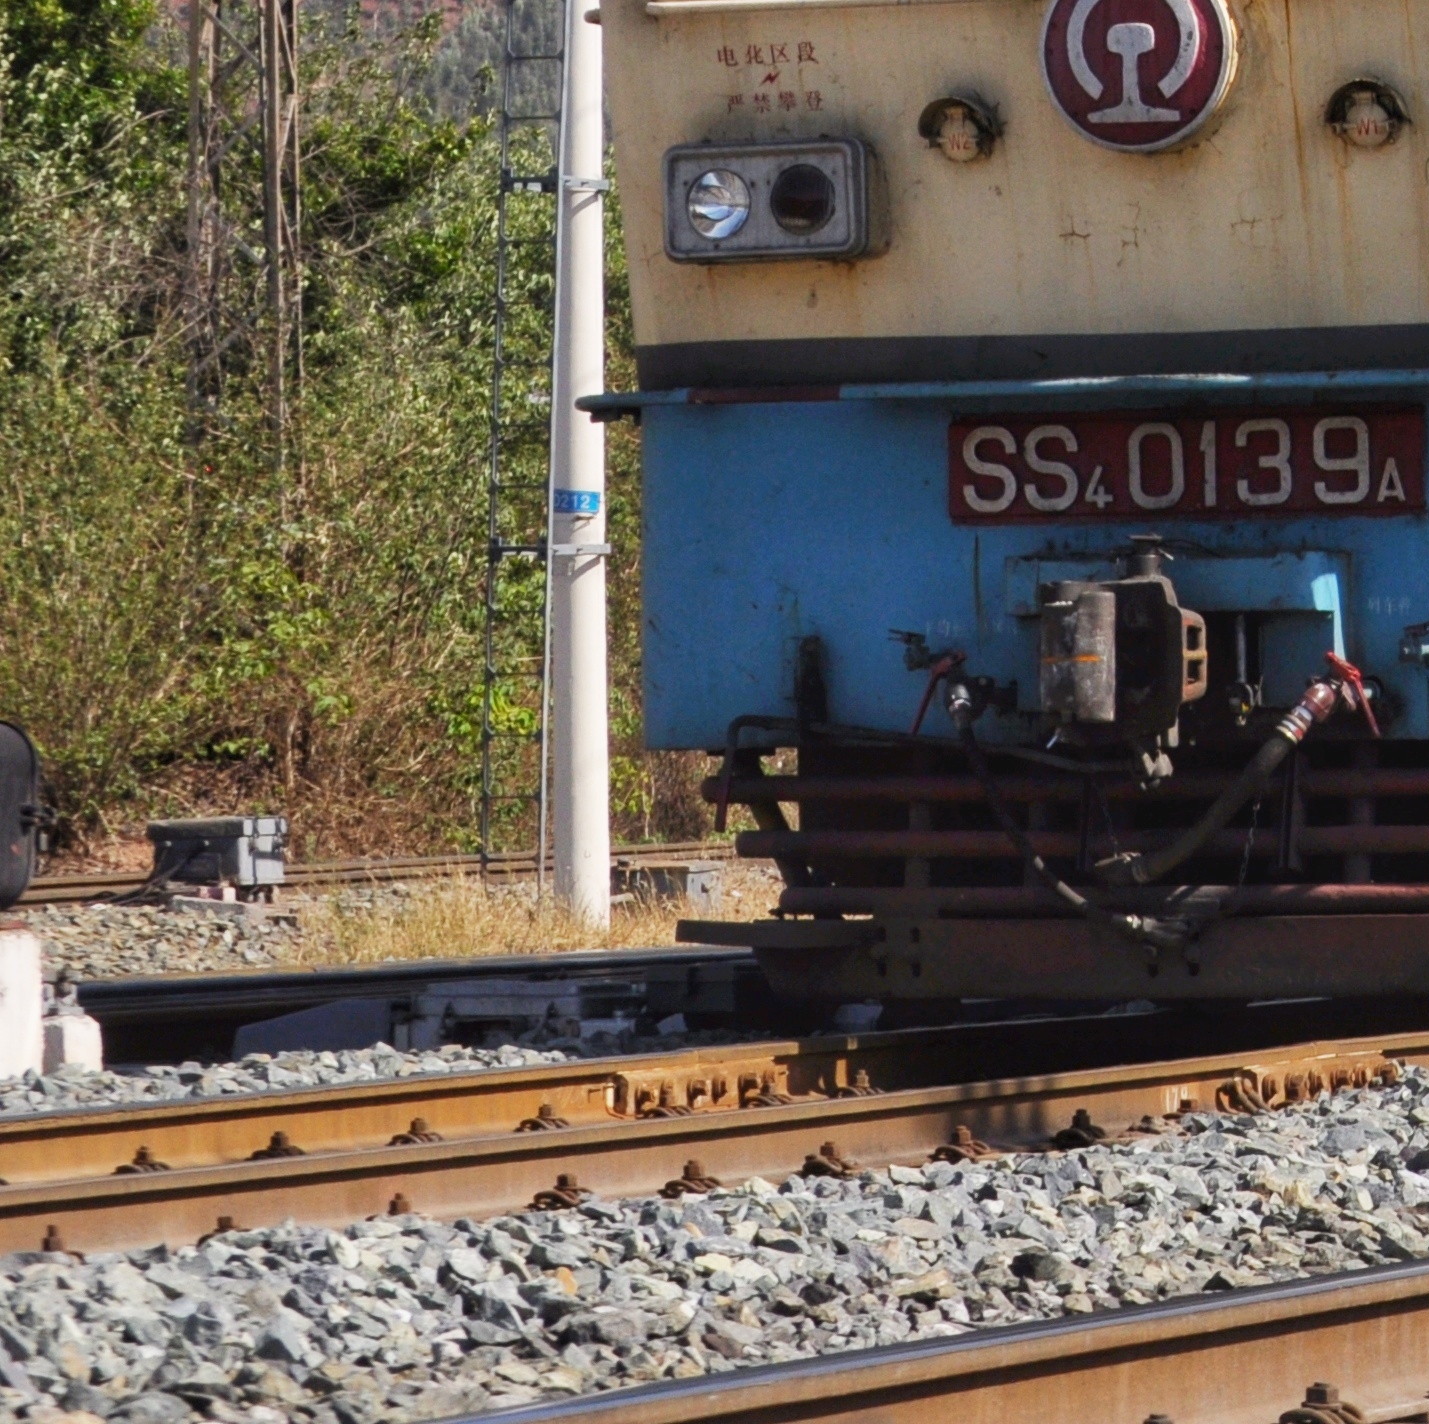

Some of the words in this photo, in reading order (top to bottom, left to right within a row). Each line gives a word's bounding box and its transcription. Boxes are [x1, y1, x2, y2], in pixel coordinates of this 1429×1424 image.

[717, 41, 819, 67] 电化区段
[727, 90, 824, 114] 严禁攀登
[1357, 118, 1379, 136] W1
[948, 131, 971, 150] W2
[962, 415, 1407, 514] SS40139A
